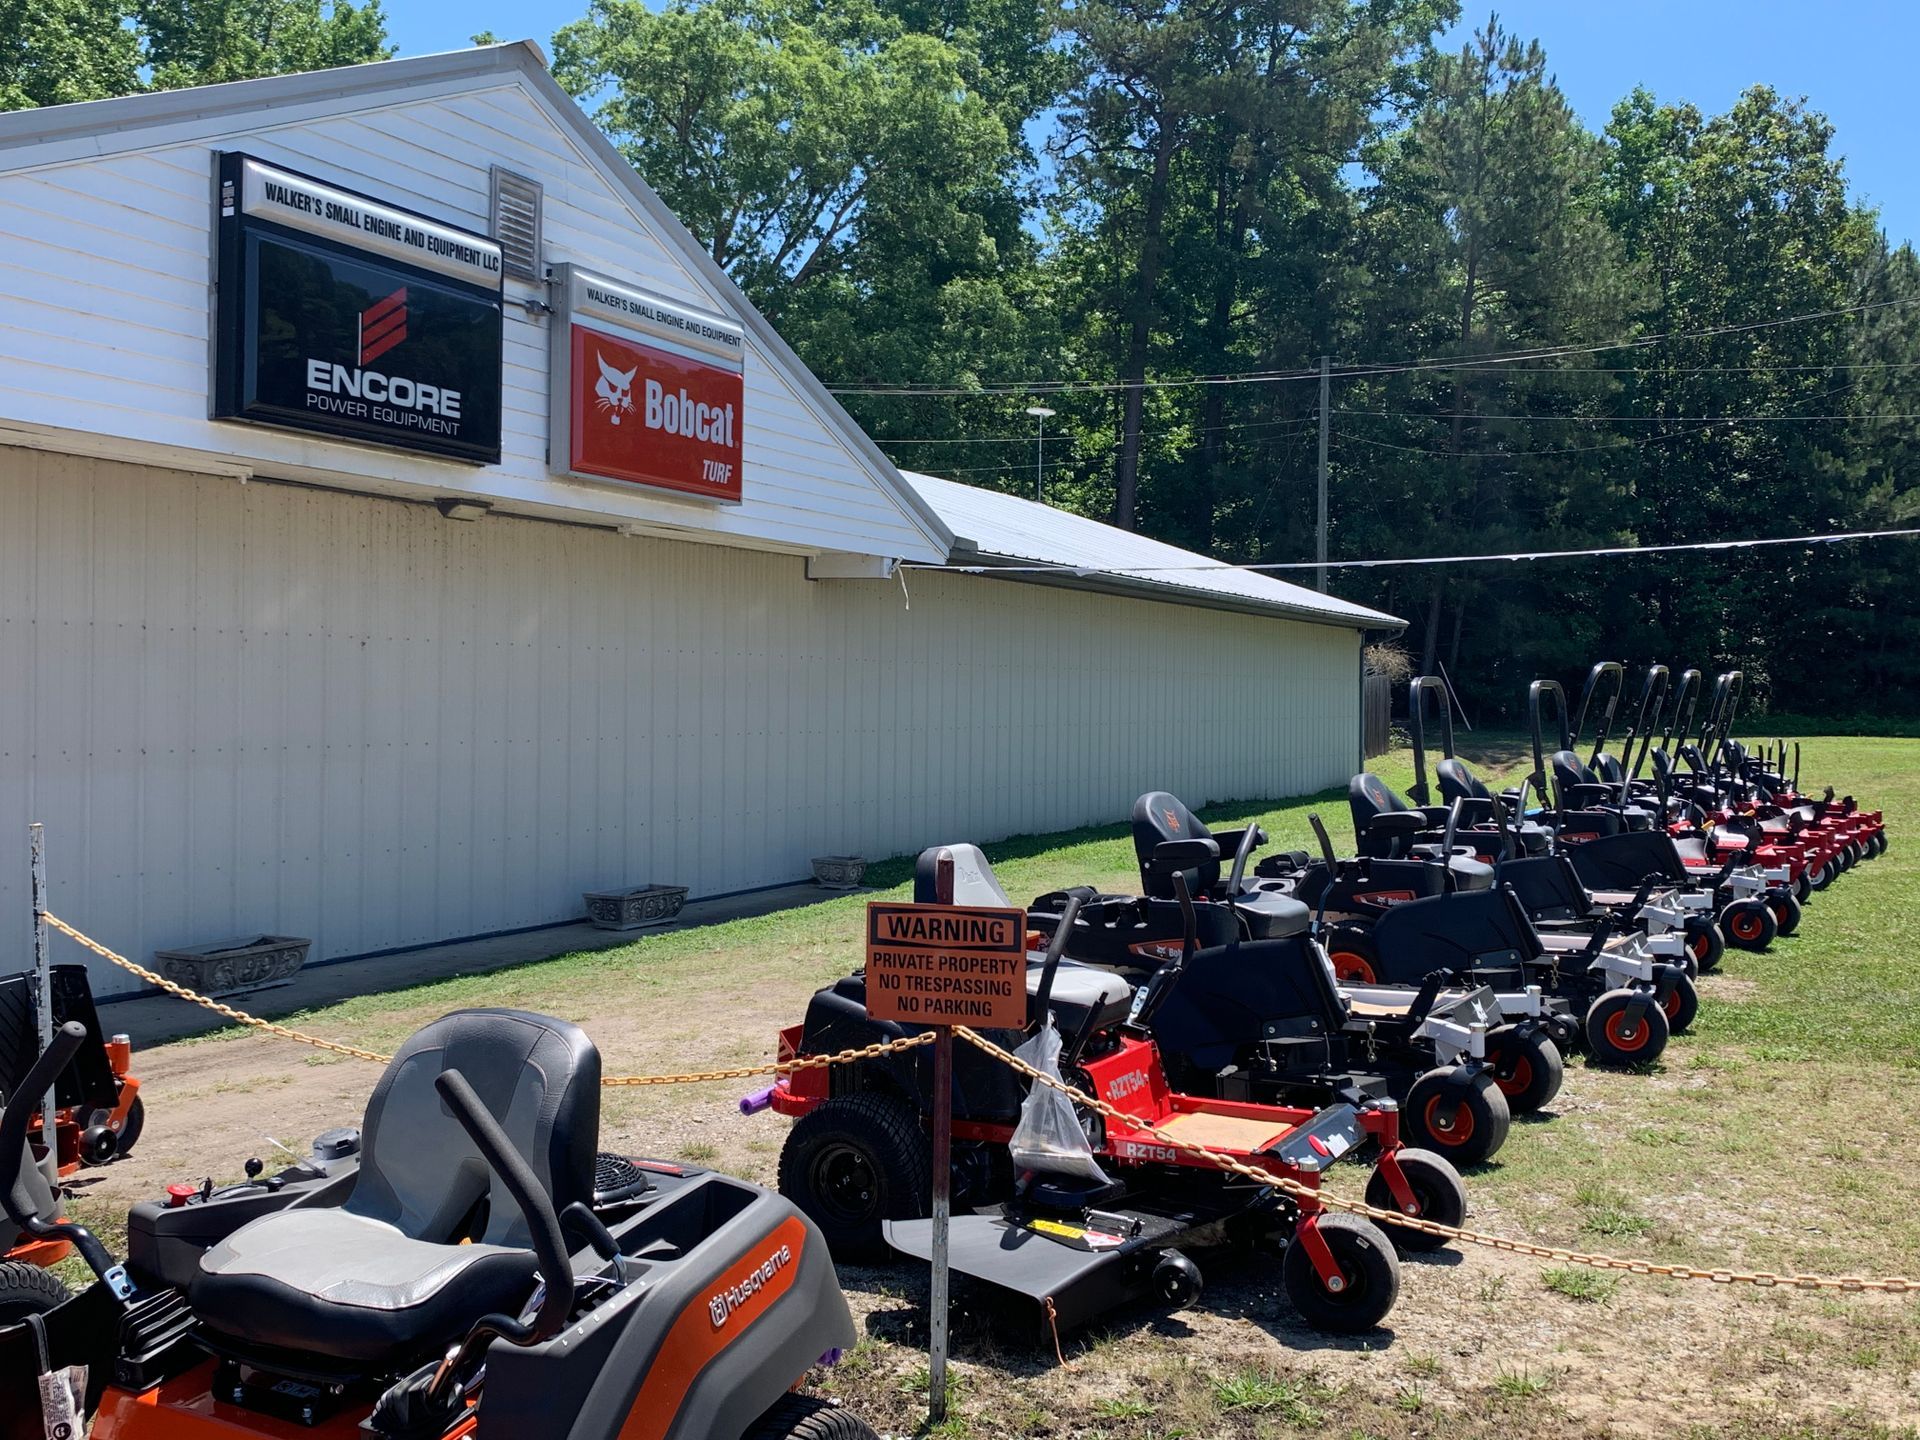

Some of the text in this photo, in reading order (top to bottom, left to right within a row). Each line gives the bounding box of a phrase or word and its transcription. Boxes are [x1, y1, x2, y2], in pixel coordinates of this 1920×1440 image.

[265, 181, 499, 272] WALKER'S SMALL ENGINE AND EQUIPMENT LLC
[587, 287, 741, 348] WALKER'S SMALL ENGINE AND EQUIPMENT
[307, 358, 462, 419] ENCORE
[307, 393, 461, 436] POWER EQUIPMENT
[645, 378, 734, 449] Bobcat
[703, 459, 733, 485] TURF
[887, 915, 1005, 944] WARNING
[873, 952, 1019, 976] PRIVATE PROPERTY
[879, 973, 1012, 997] NO TRESPASSING
[897, 996, 993, 1017] NO PARKING
[1109, 1068, 1146, 1101] RZT54
[1126, 1142, 1177, 1162] RZT54
[724, 1244, 792, 1313] Husqvarna
